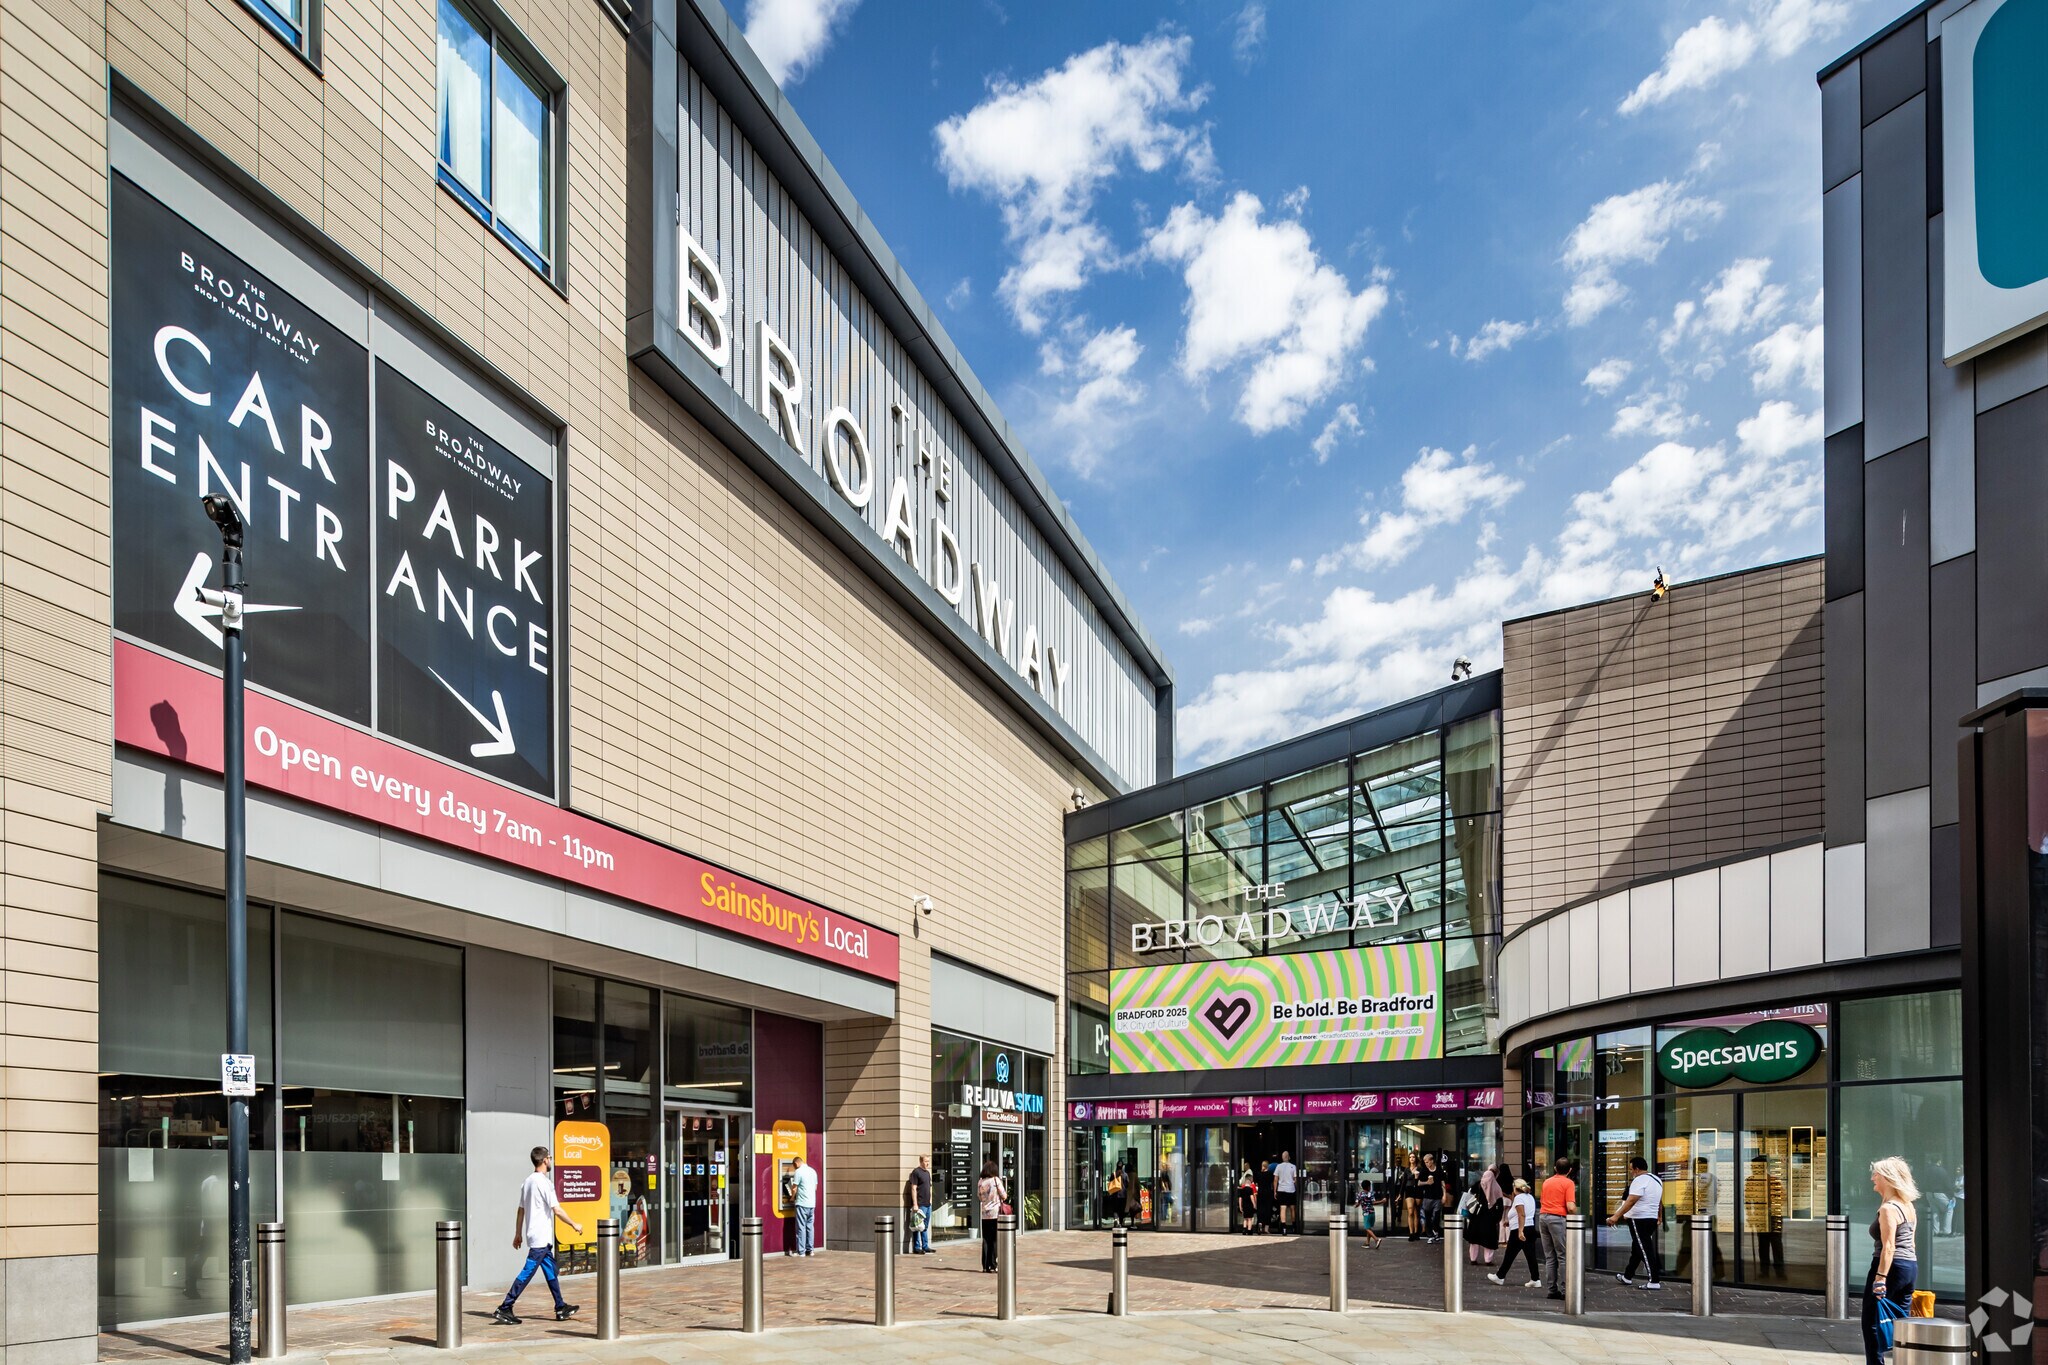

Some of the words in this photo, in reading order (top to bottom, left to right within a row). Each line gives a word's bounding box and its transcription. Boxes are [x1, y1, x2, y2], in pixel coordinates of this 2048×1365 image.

[243, 280, 266, 300] THE
[181, 251, 320, 356] BROADWAY
[194, 284, 218, 303] SHOP
[228, 306, 257, 330] WATCH
[266, 331, 281, 345] EAT
[290, 347, 309, 364] PLAY
[468, 436, 484, 452] THE
[891, 402, 952, 501] THE
[154, 325, 337, 484] CAR
[388, 459, 543, 605] PARK
[426, 420, 522, 494] BROADWAY
[678, 224, 1070, 711] BROADWAY
[435, 445, 452, 459] SHOP
[457, 460, 478, 478] WATCH
[500, 488, 514, 501] PLAY
[253, 725, 341, 782] Open
[350, 765, 432, 816] every
[438, 791, 488, 835] day
[492, 809, 542, 847] 7am
[563, 835, 614, 872] 11pm
[1243, 882, 1286, 901] THE
[700, 872, 819, 944] Sainsbury's
[824, 916, 869, 959] Local
[1131, 893, 1408, 953] BROADWAY
[1117, 1009, 1164, 1020] BRADFORD
[1166, 1008, 1187, 1017] 2025
[1273, 1005, 1293, 1019] Be
[1296, 1002, 1334, 1018] bold.
[1337, 1000, 1358, 1015] Be
[1361, 994, 1434, 1013] Bradford
[1117, 1021, 1128, 1031] UK
[1130, 1021, 1145, 1032] City
[1147, 1020, 1156, 1029] of
[1157, 1019, 1187, 1029] Culture
[1670, 1040, 1798, 1074] Specsavers
[1274, 1099, 1293, 1112] PRET
[1307, 1100, 1342, 1108] PRIMARK
[1349, 1095, 1378, 1111] Boots
[1391, 1096, 1420, 1107] next
[1474, 1091, 1496, 1106] H&M
[564, 1149, 582, 1159] Local
